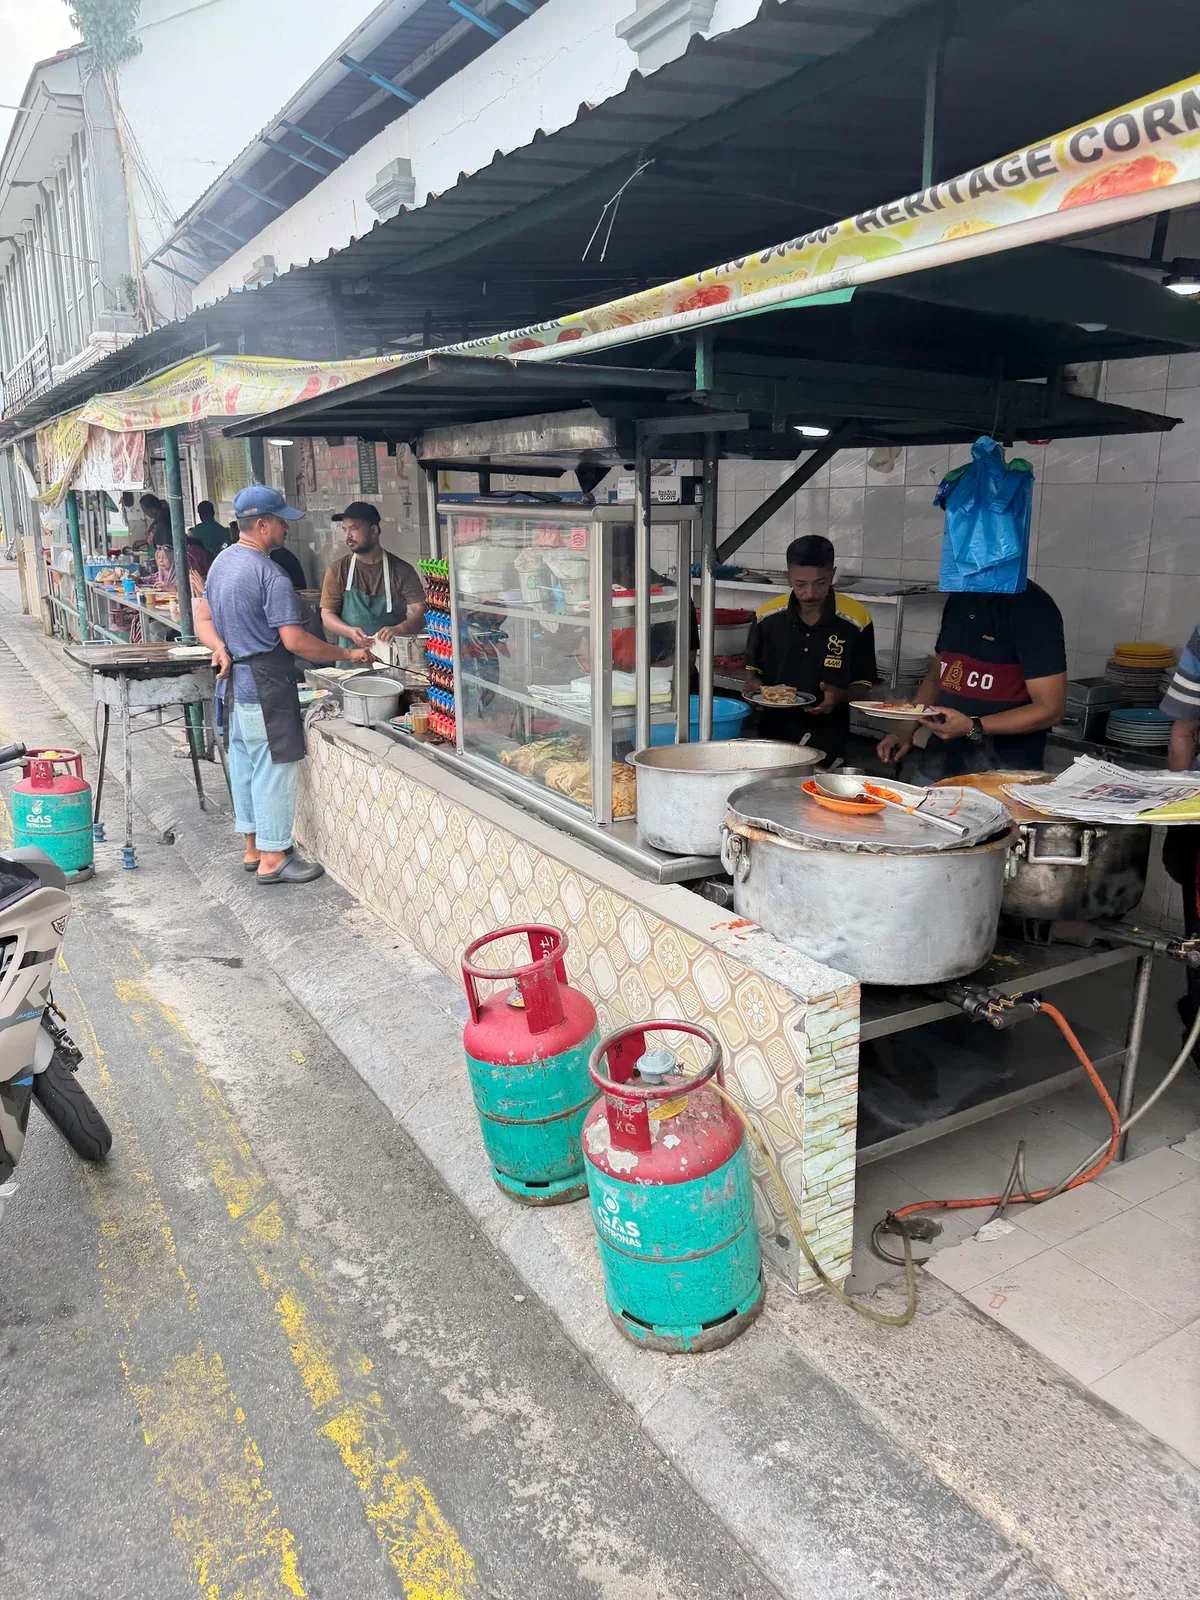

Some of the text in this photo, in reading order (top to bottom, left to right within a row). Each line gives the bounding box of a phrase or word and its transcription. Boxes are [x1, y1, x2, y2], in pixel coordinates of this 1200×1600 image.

[26, 814, 52, 823] GAS
[615, 1120, 637, 1135] KG
[597, 1206, 641, 1238] GAS
